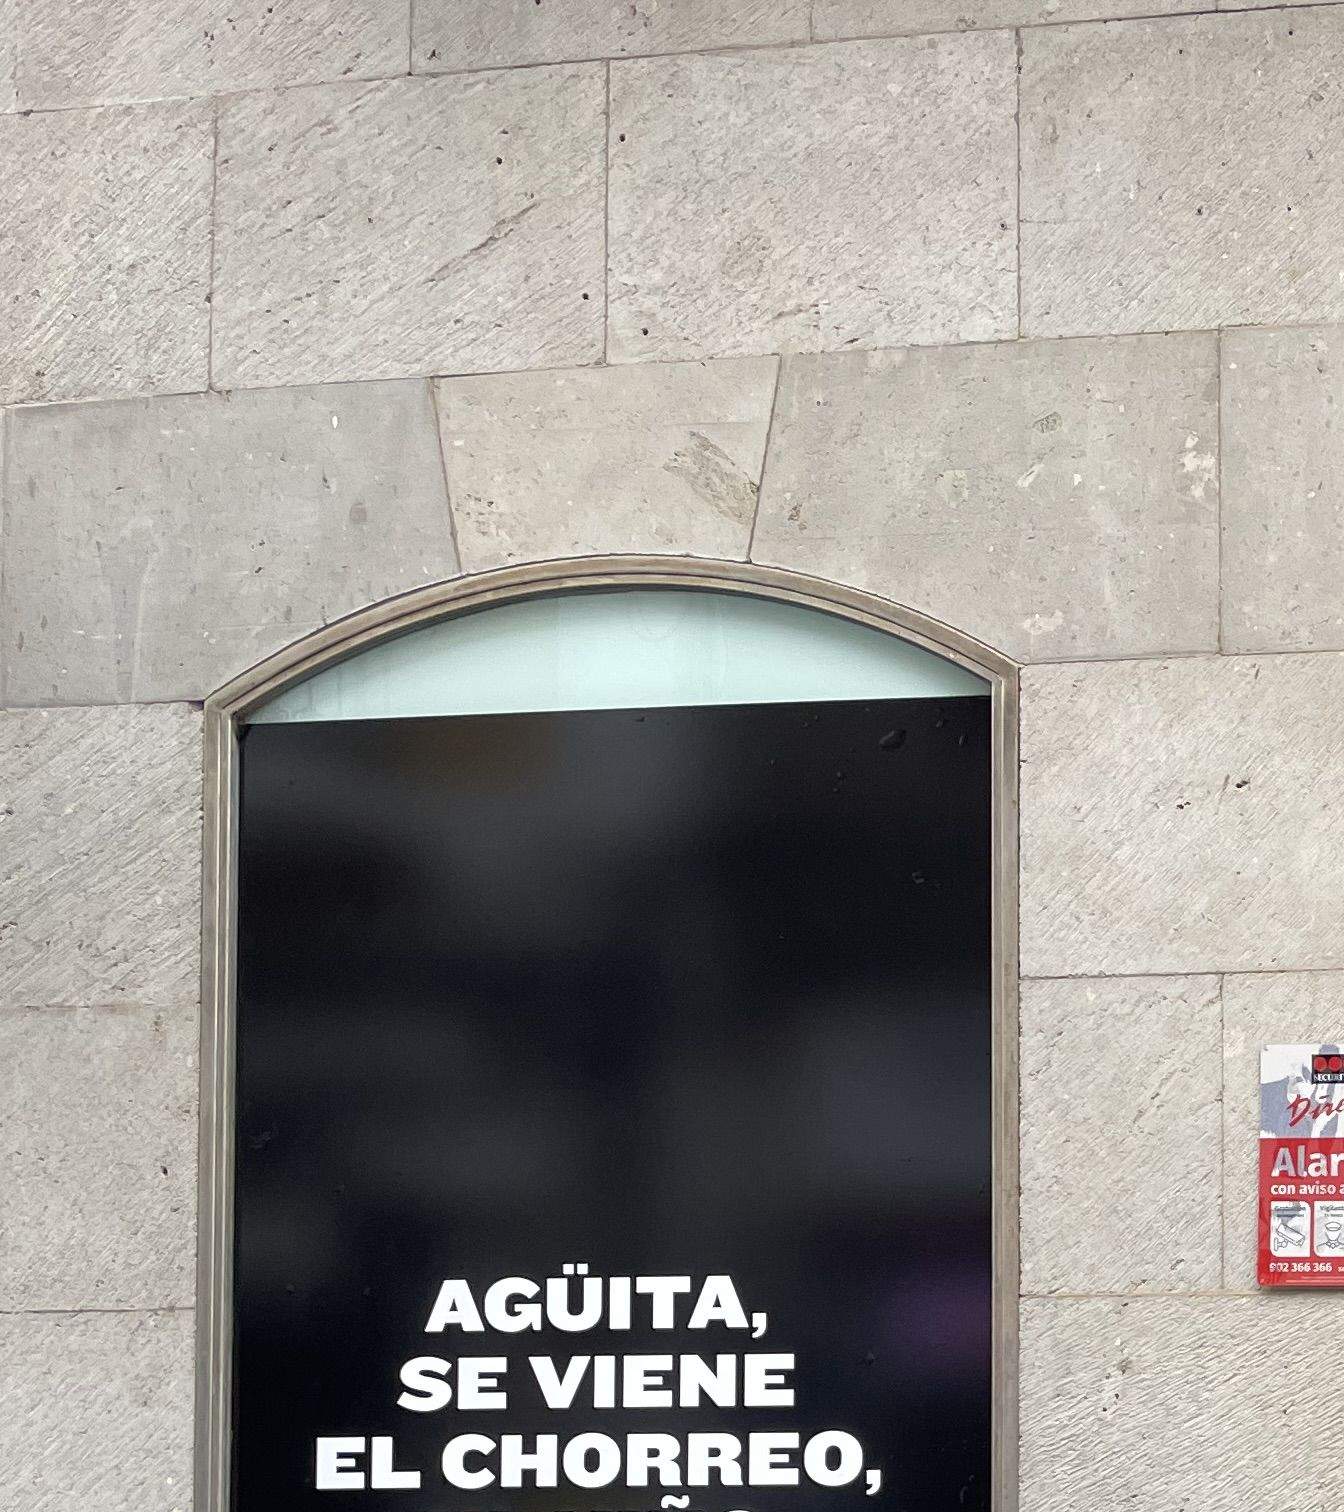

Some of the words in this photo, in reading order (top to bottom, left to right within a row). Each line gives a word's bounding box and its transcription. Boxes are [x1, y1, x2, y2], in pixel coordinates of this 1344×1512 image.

[1270, 1183, 1296, 1195] con
[1299, 1180, 1337, 1195] aviso
[1291, 1262, 1312, 1273] 366
[1313, 1262, 1333, 1273] 366
[424, 1263, 768, 1340] AGÜITA,
[397, 1356, 508, 1412] SE
[528, 1353, 796, 1410] VIENE
[316, 1436, 421, 1491] EL
[441, 1430, 883, 1497] CHORREO,
